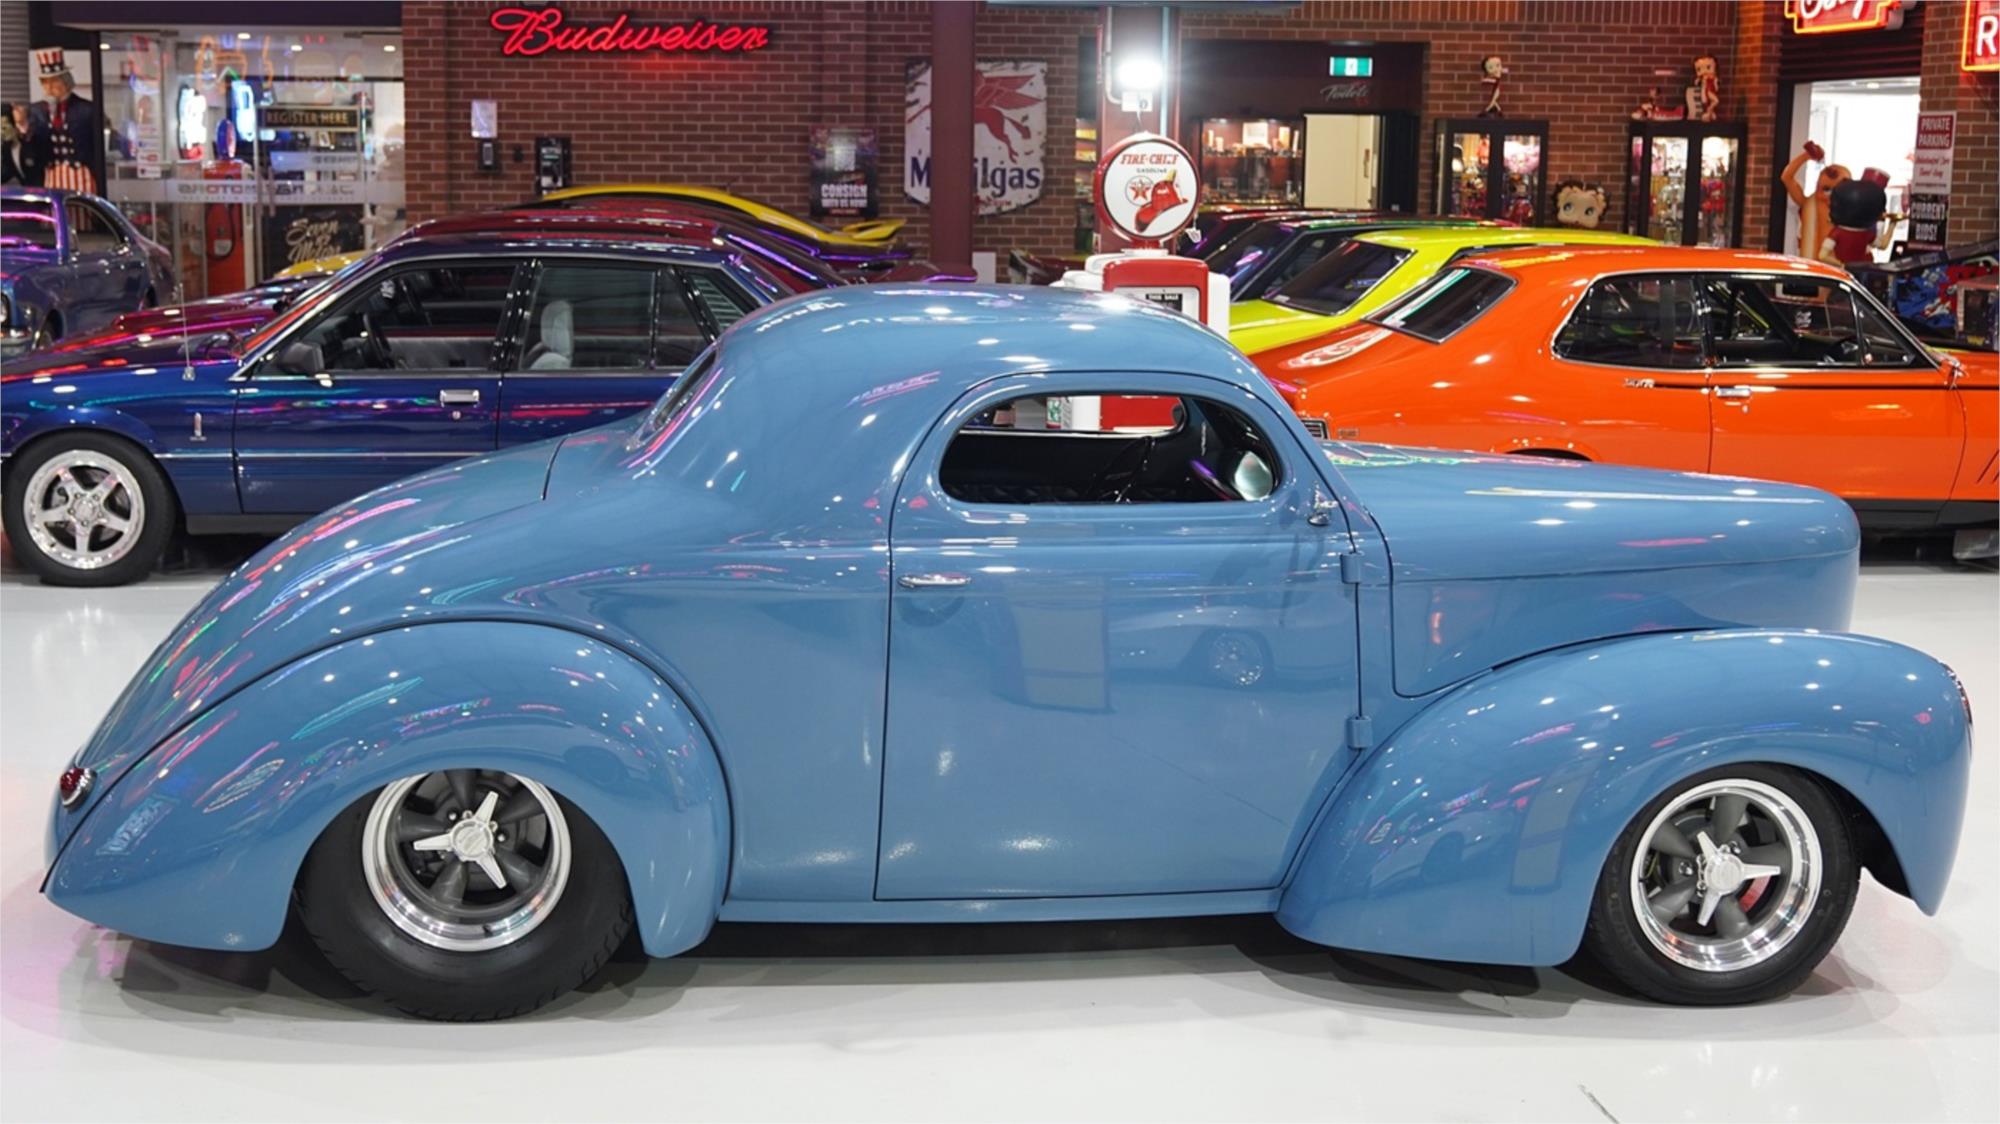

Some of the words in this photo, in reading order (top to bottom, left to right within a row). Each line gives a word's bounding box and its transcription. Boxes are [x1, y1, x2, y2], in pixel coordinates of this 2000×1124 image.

[490, 8, 769, 55] Budweiser
[266, 111, 318, 123] REGISTER
[321, 112, 348, 123] HERE
[1921, 118, 1950, 130] PRIVATE
[1919, 134, 1949, 147] PARKING
[821, 184, 868, 198] CONSIGN
[1911, 202, 1946, 220] CURRENT
